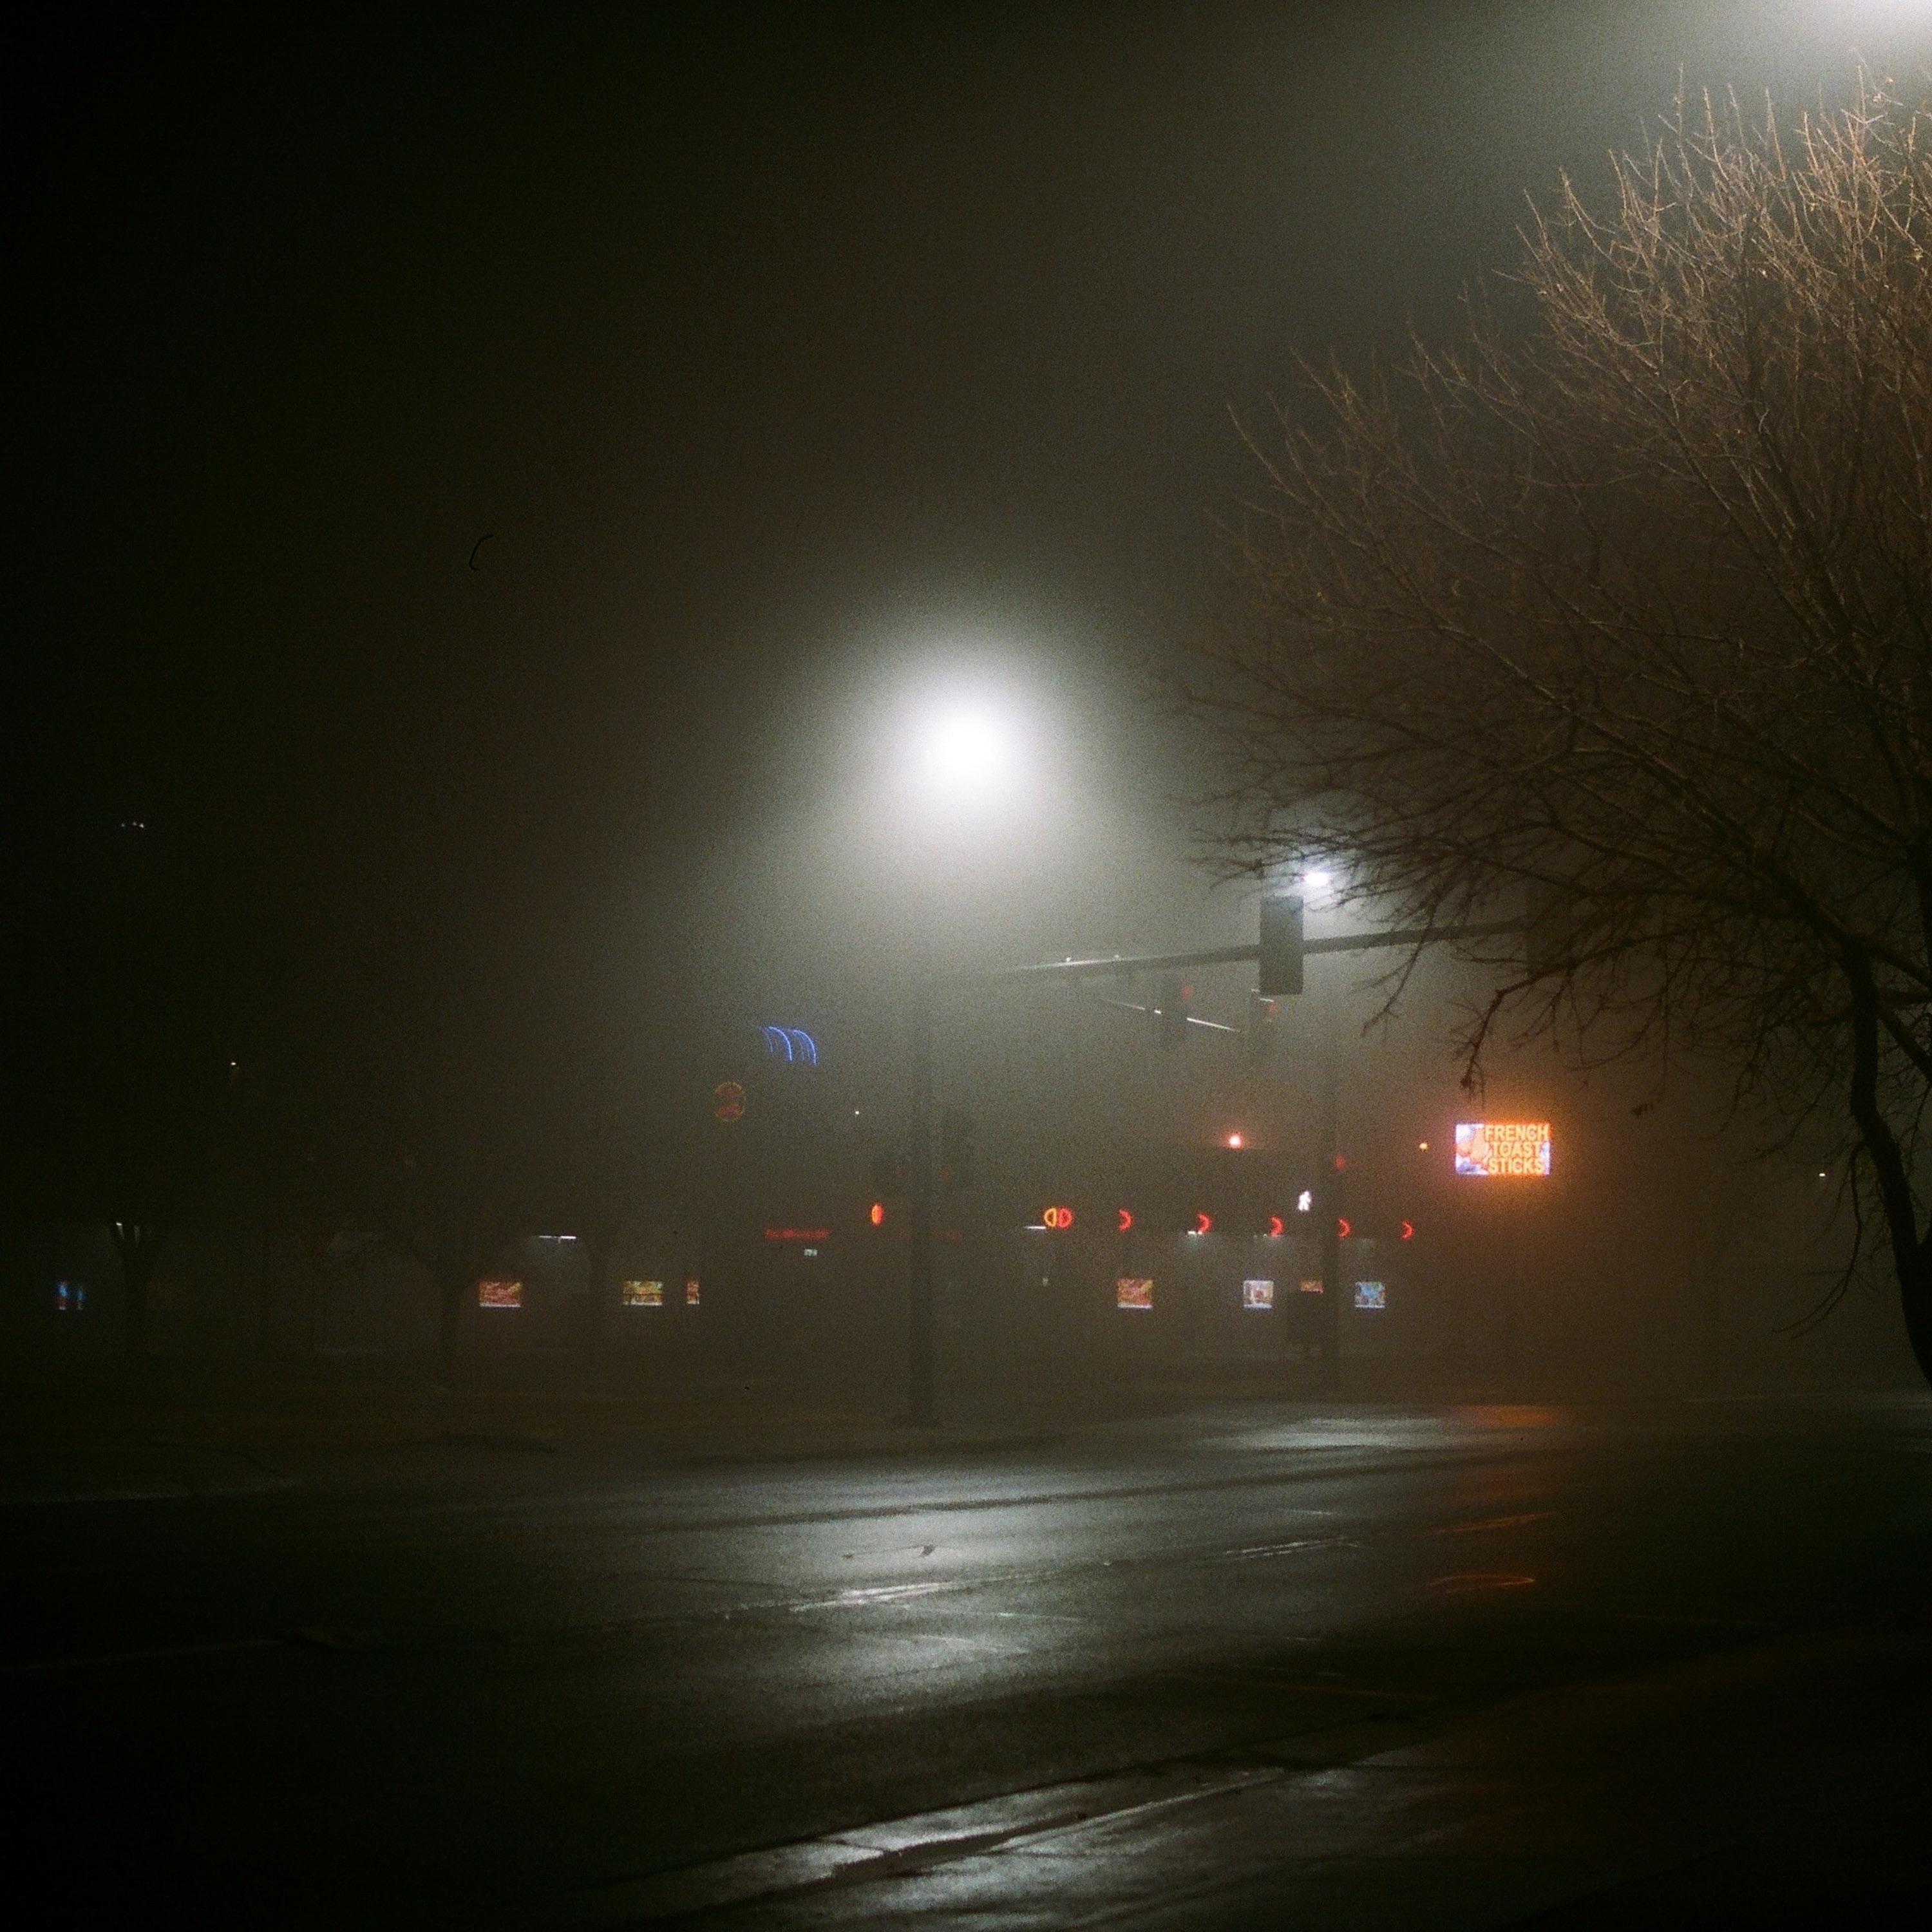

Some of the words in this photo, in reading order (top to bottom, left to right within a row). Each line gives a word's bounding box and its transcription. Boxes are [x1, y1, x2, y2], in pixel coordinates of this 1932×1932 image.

[1485, 1125, 1549, 1141] FRENCH
[1491, 1141, 1542, 1157] TOAST
[1488, 1157, 1544, 1174] STICKS
